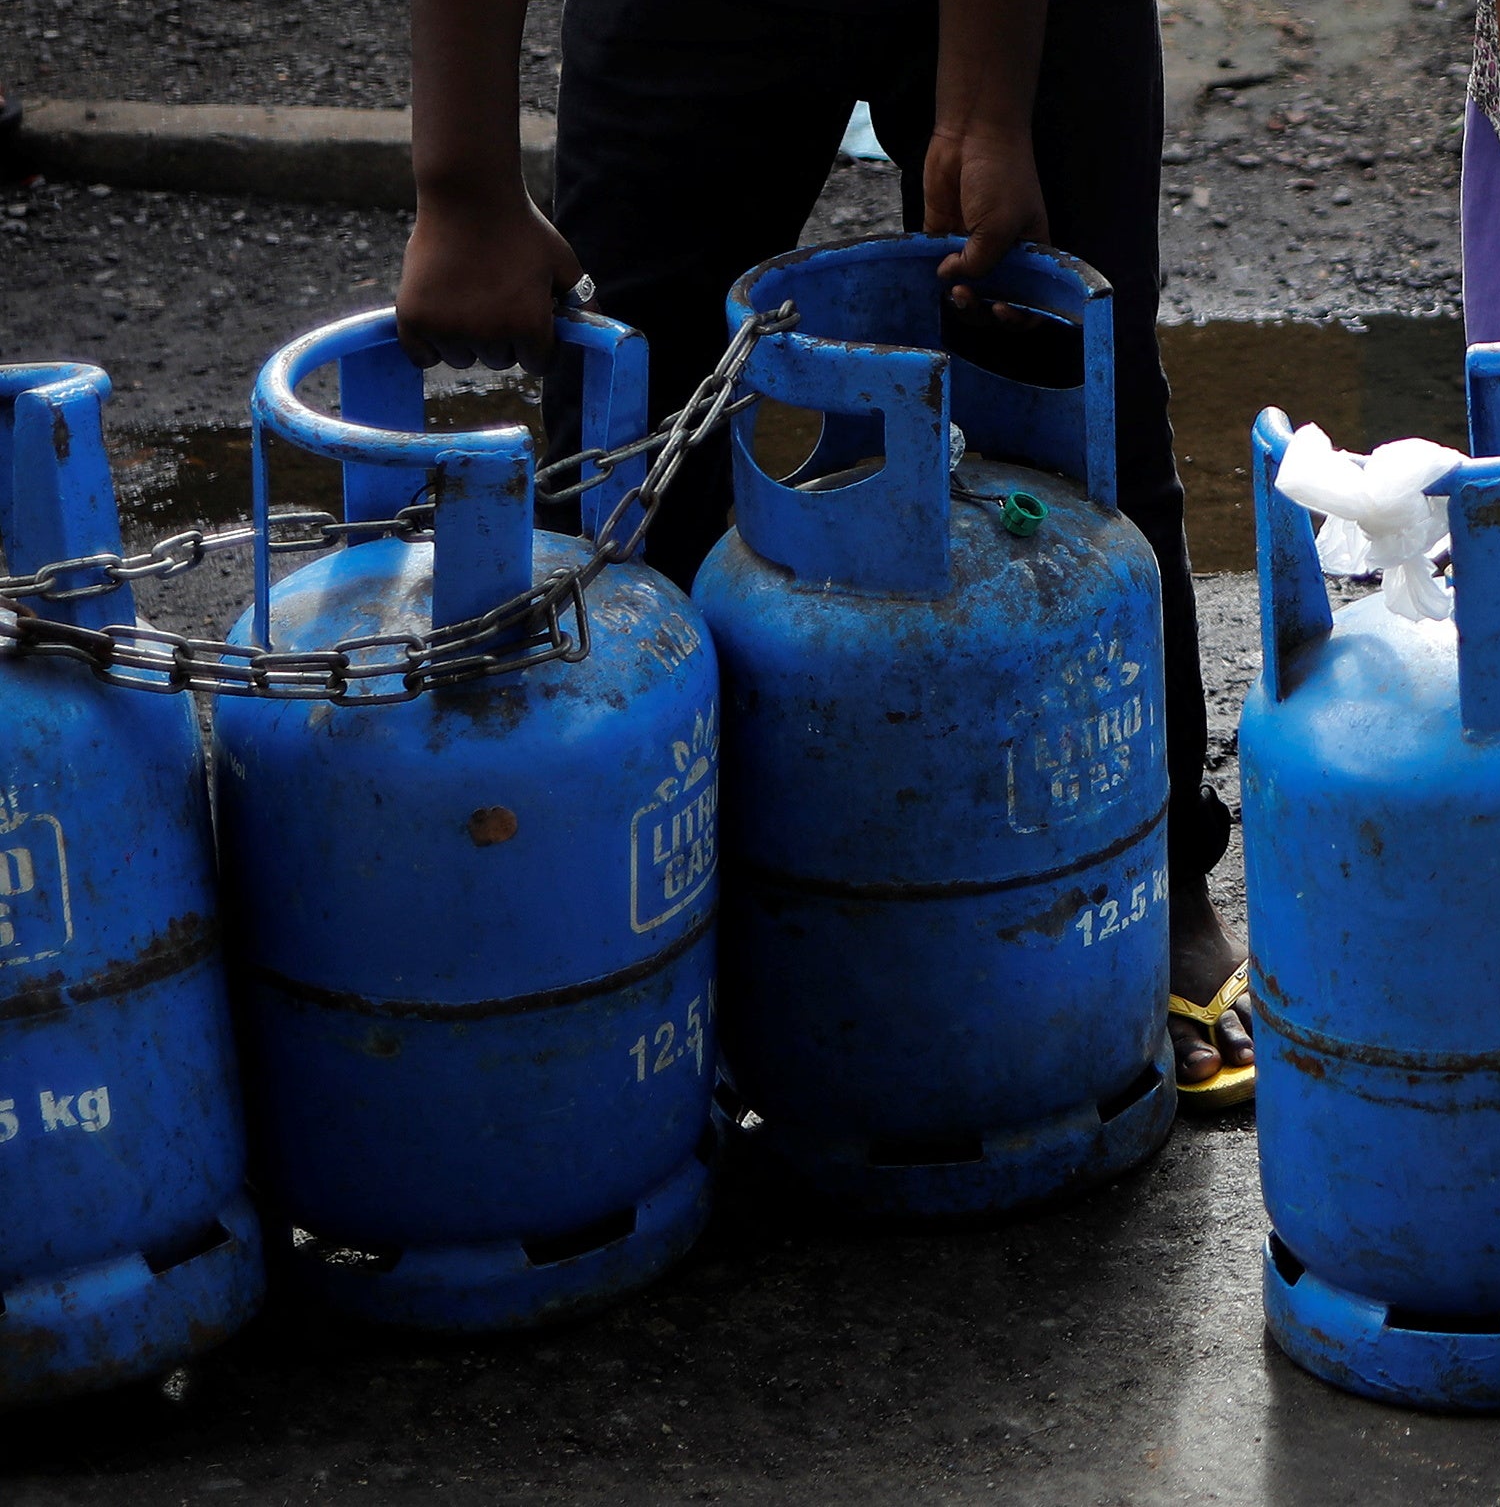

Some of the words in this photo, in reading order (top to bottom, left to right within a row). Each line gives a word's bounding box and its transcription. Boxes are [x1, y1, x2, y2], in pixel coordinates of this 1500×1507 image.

[1035, 693, 1143, 772] LITRO
[663, 820, 716, 900] GAS
[1075, 880, 1147, 948] 12.5
[629, 994, 704, 1083] 12.5
[39, 1085, 111, 1133] kg
